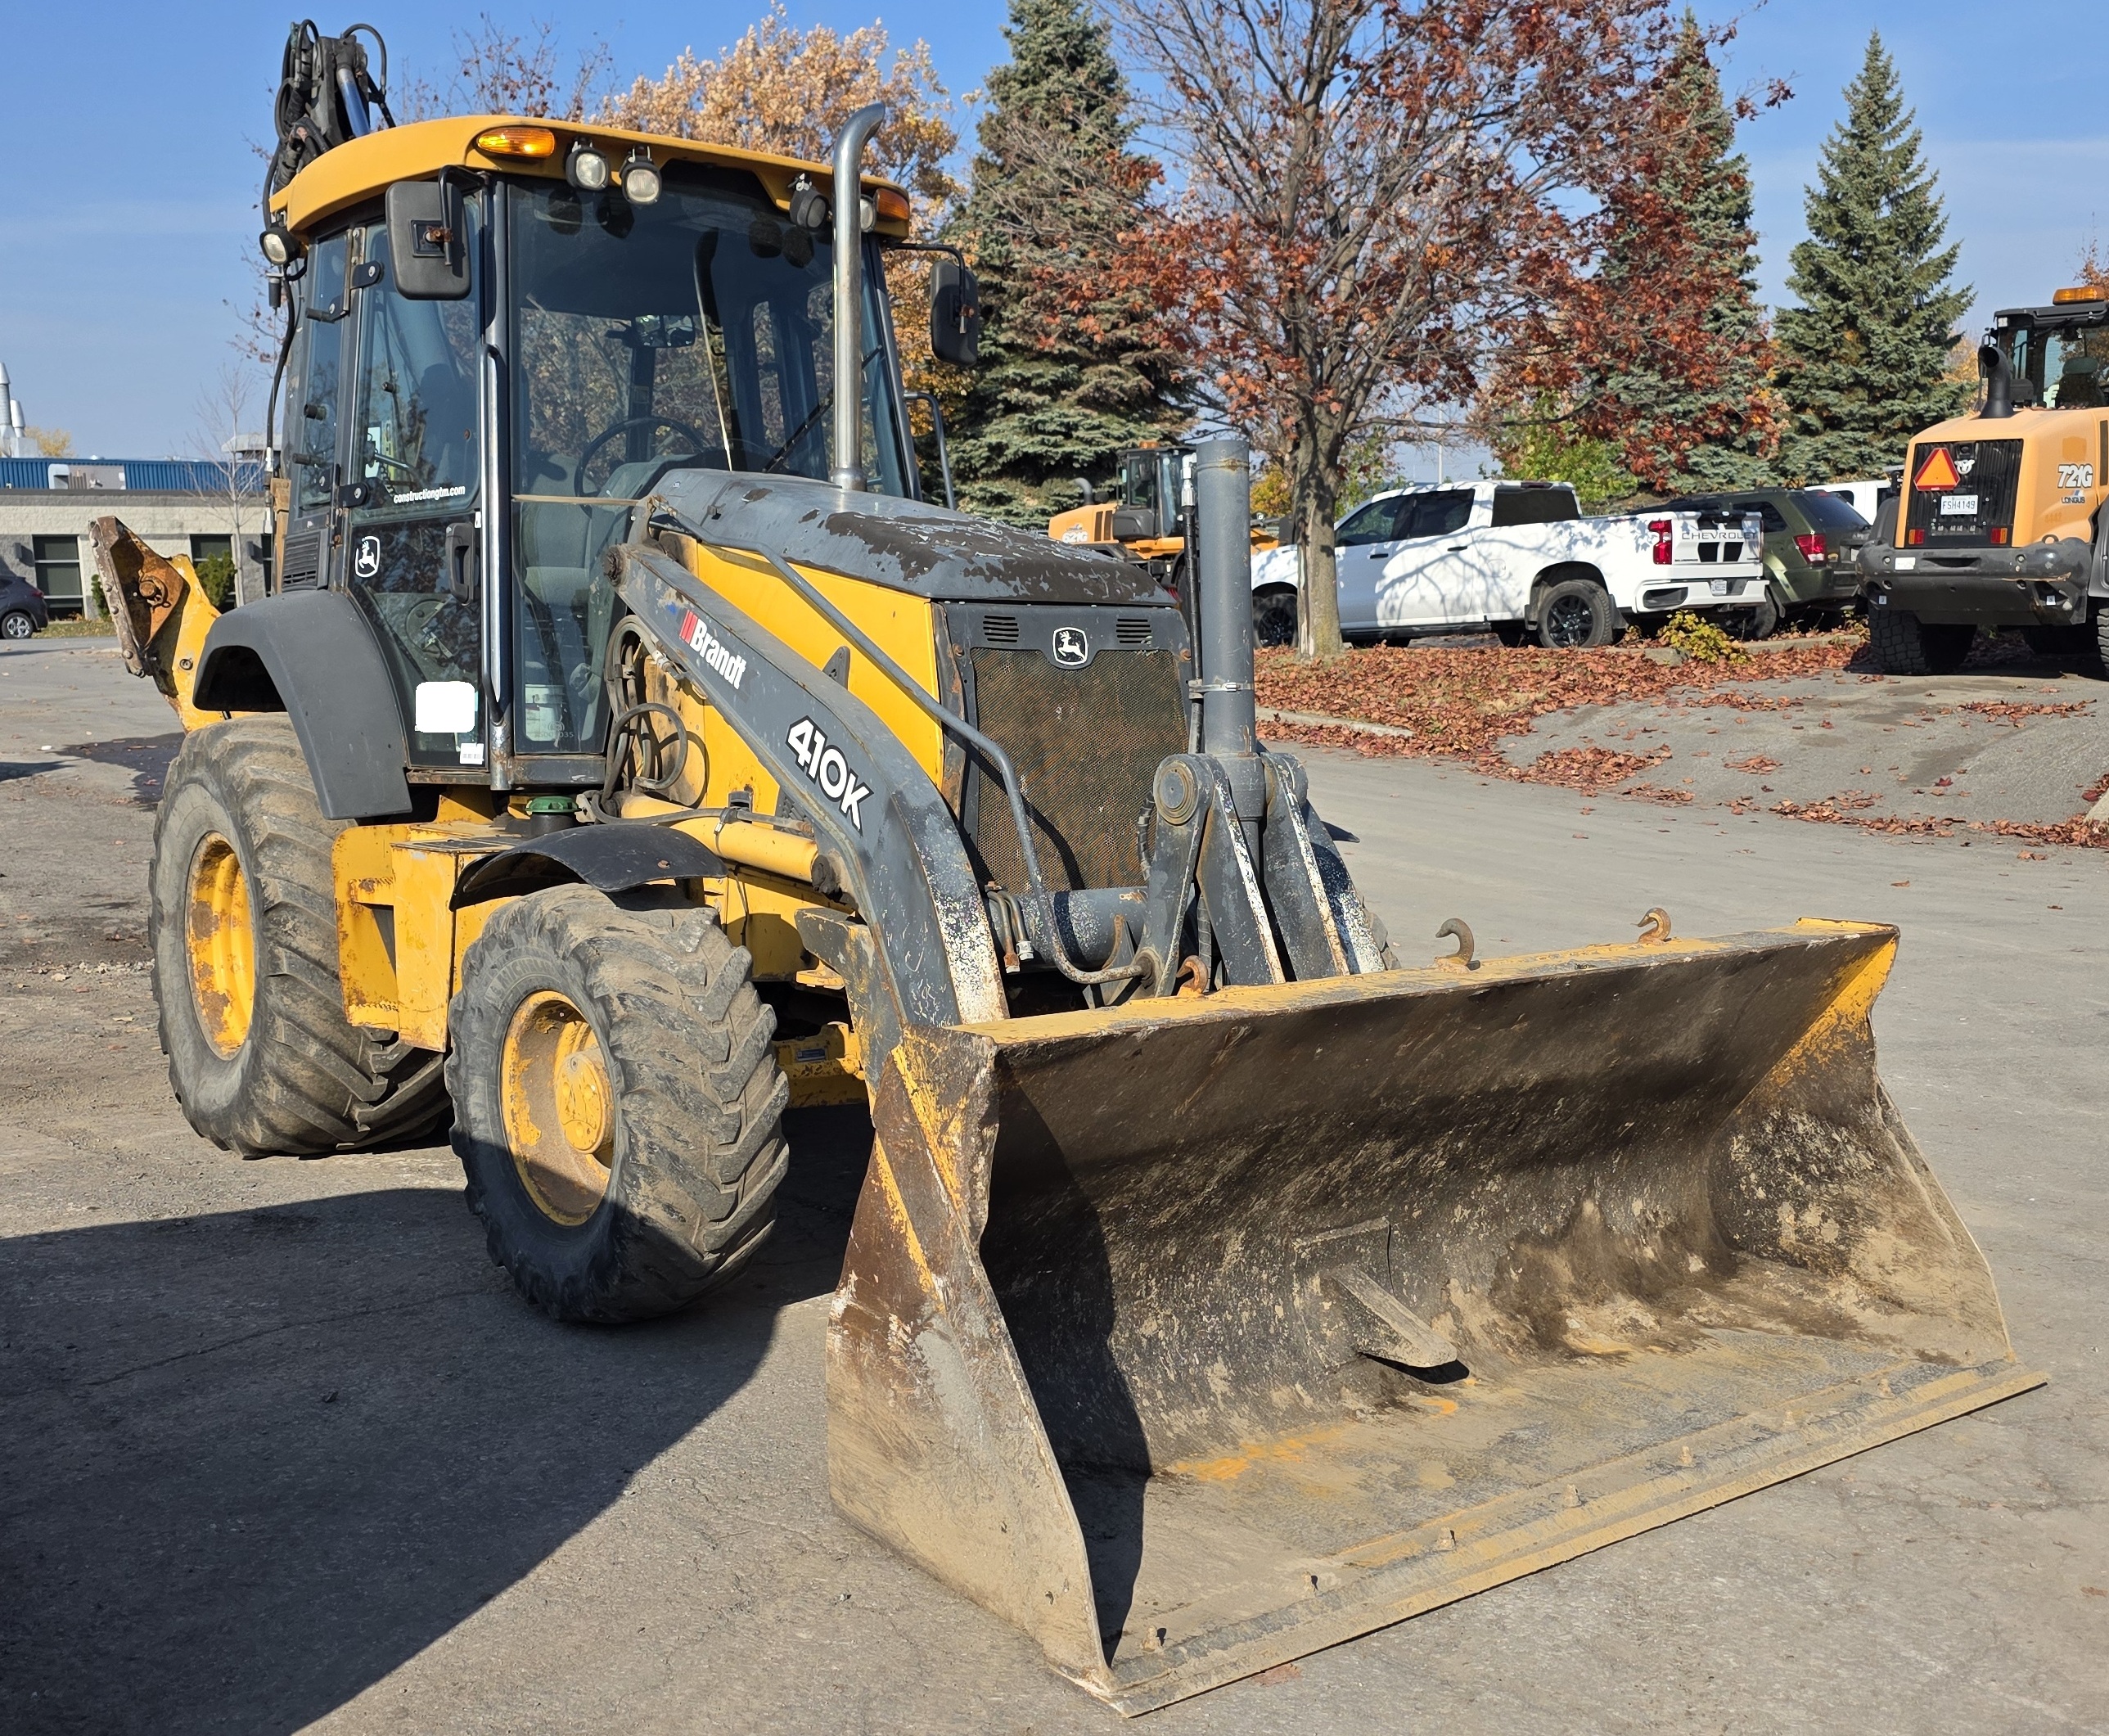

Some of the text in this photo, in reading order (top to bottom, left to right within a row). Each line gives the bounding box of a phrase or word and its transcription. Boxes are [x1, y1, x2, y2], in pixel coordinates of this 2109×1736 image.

[393, 486, 466, 504] constructiongtm.com
[2057, 463, 2093, 488] 721G
[689, 617, 747, 690] Brandt
[787, 717, 872, 832] 410K
